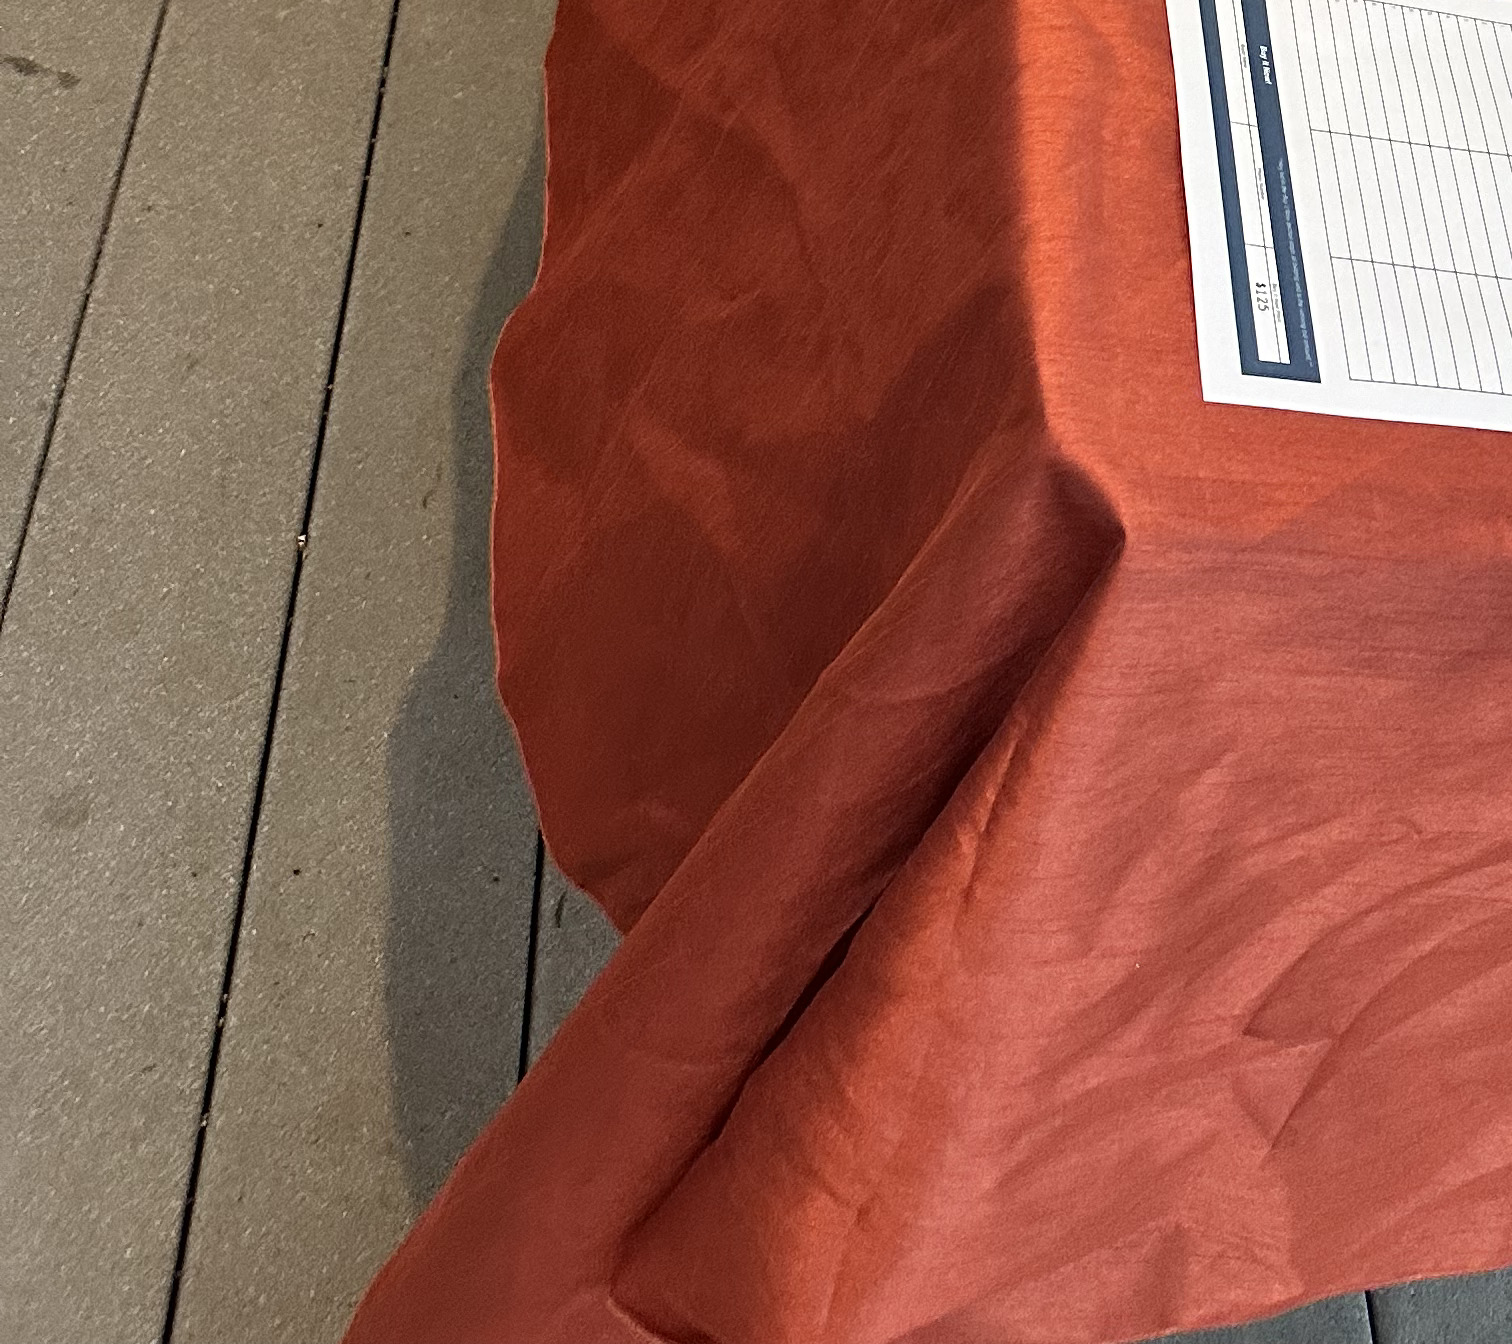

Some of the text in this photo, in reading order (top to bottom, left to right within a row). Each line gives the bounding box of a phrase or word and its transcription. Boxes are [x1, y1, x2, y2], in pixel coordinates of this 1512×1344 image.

[1258, 45, 1268, 59] Buy
[1262, 65, 1271, 84] Now!
[1255, 282, 1268, 311] $125
